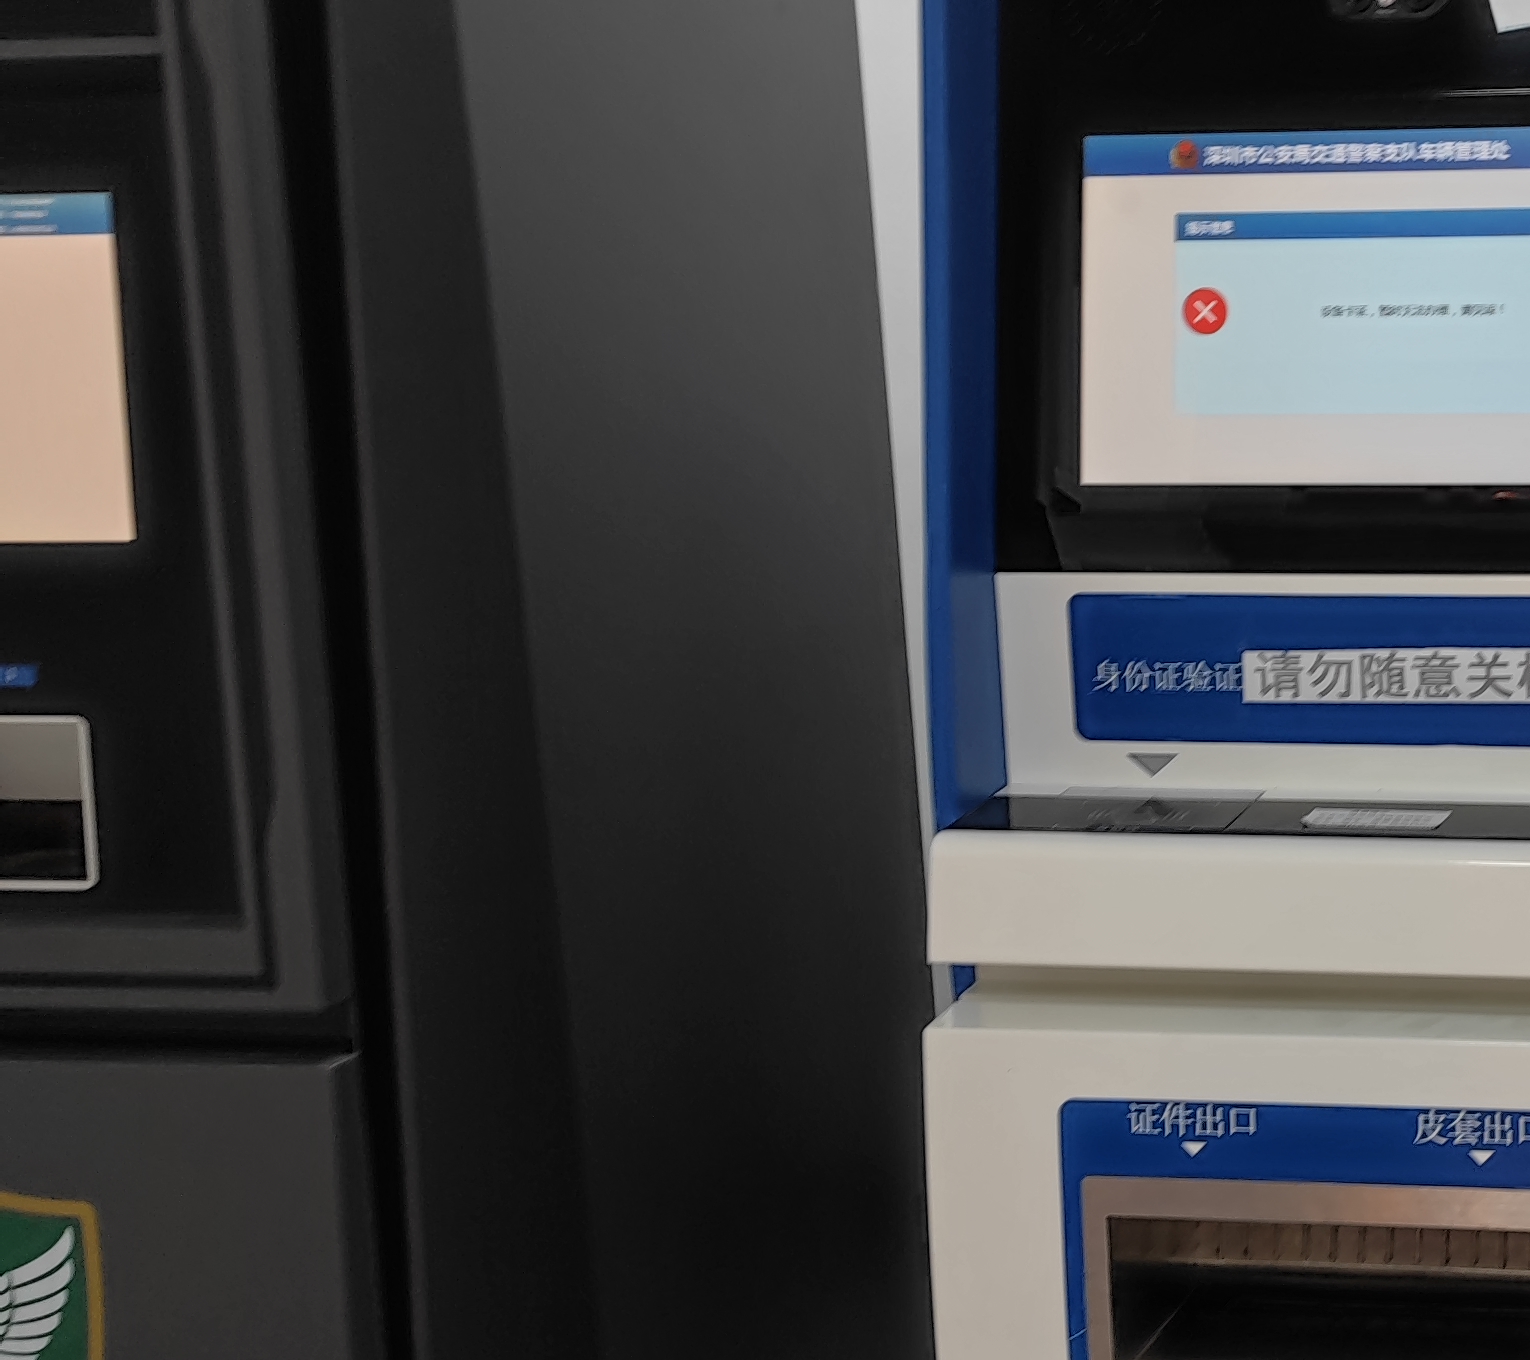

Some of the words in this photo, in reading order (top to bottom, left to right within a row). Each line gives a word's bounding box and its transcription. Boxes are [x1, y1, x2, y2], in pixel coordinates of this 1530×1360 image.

[1092, 660, 1242, 695] 身份证验证
[1126, 1102, 1259, 1138] 证件出口
